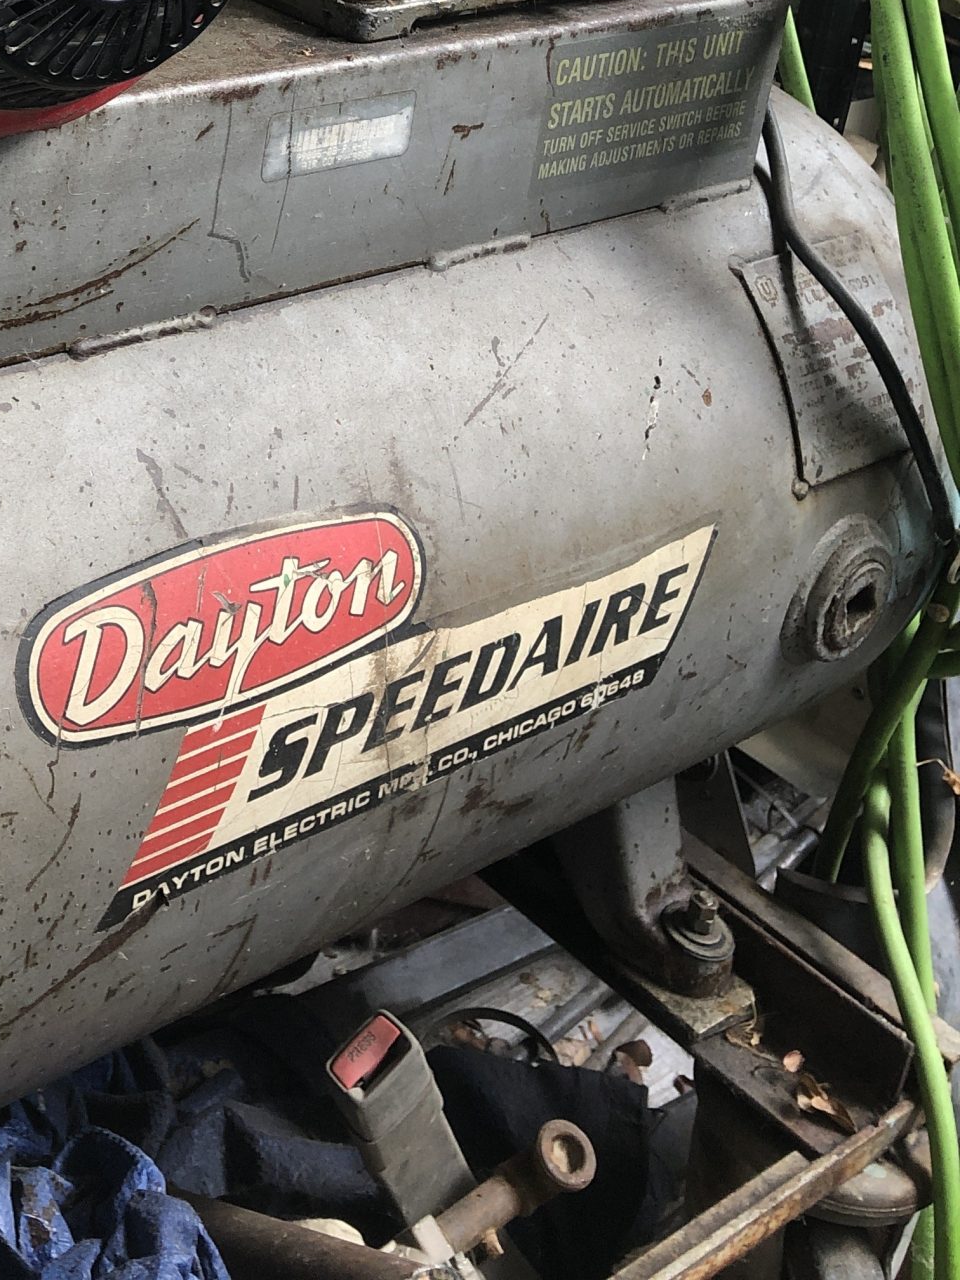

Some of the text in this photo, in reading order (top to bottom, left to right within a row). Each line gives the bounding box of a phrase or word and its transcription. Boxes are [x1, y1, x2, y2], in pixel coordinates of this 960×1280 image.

[556, 30, 745, 86] CAUTION: THIS UNIT
[544, 100, 747, 156] TURN OFF SERVICE SWITCH BEFORE
[548, 66, 755, 130] STARTS AUTOMATICALLY
[538, 122, 742, 180] MAKING ADJUSTMENTS OR REPAIRS
[62, 546, 406, 727] Dayton
[247, 564, 691, 803] SPEEDAIRE
[132, 849, 249, 911] DAYTON
[253, 792, 371, 855] ELECTRIC
[482, 702, 578, 752] CHICAGO
